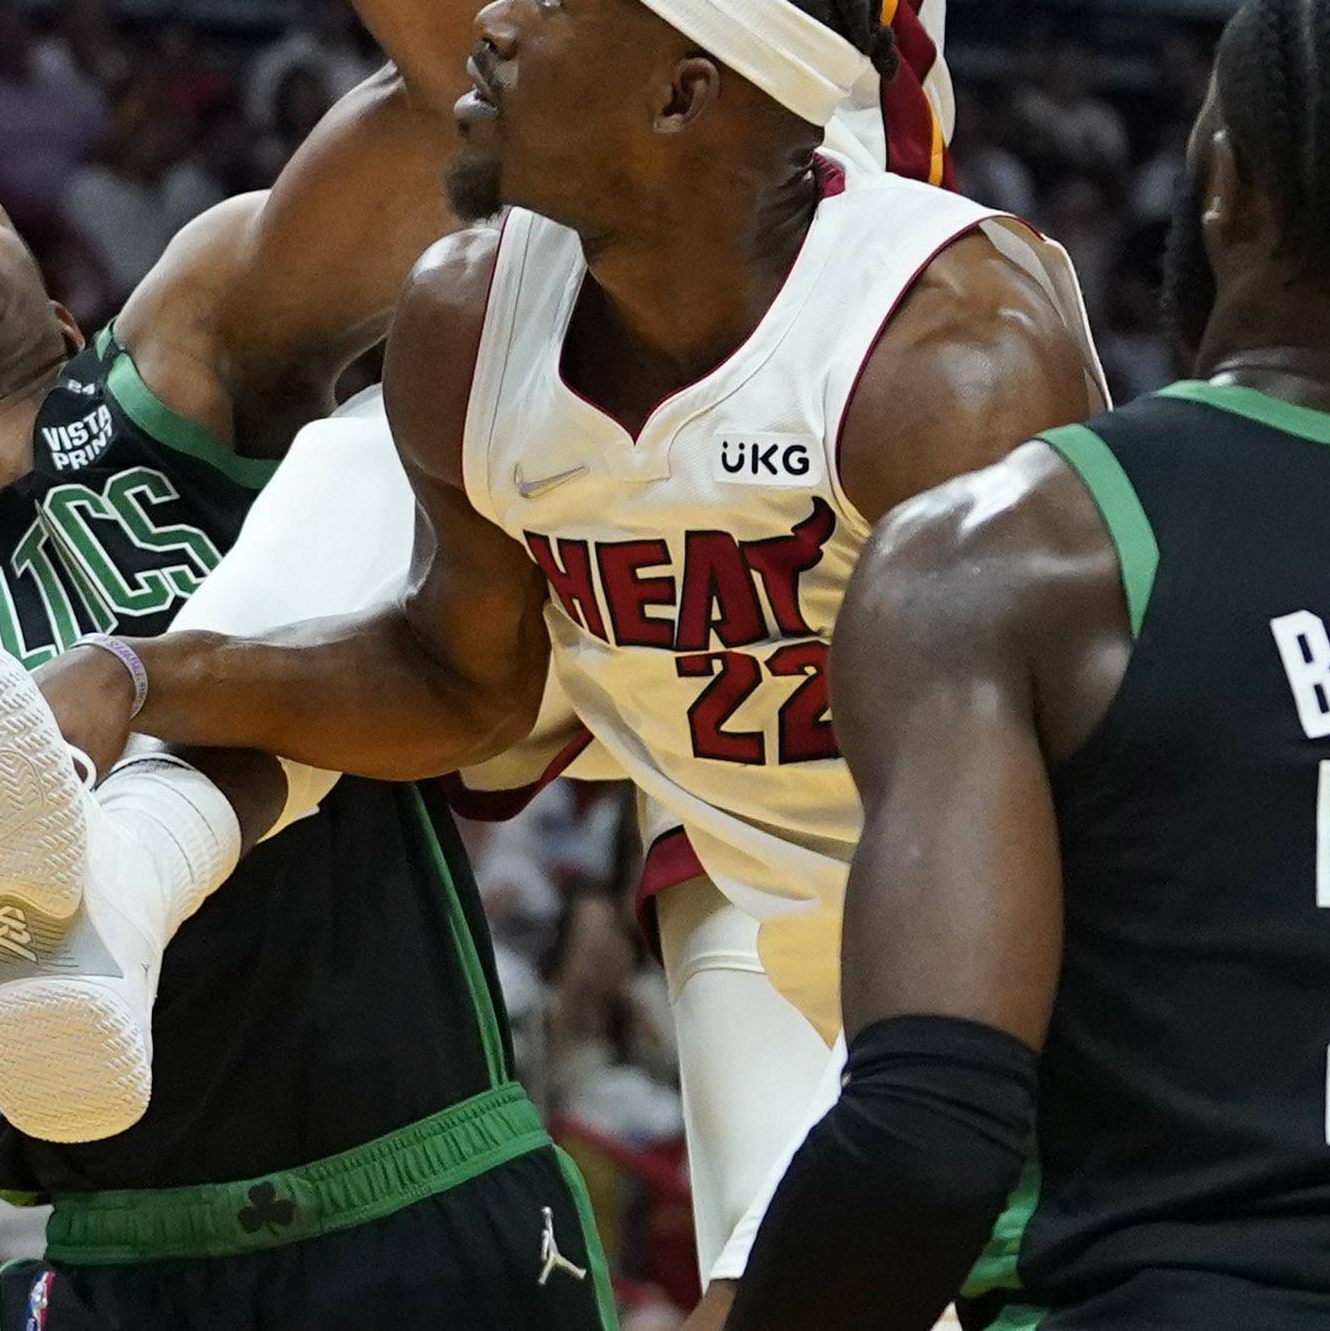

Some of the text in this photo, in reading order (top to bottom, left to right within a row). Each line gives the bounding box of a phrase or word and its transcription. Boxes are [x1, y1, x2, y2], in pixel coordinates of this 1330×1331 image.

[41, 403, 113, 452] VISTA
[522, 495, 837, 651] HEAT
[675, 640, 842, 766] 22
